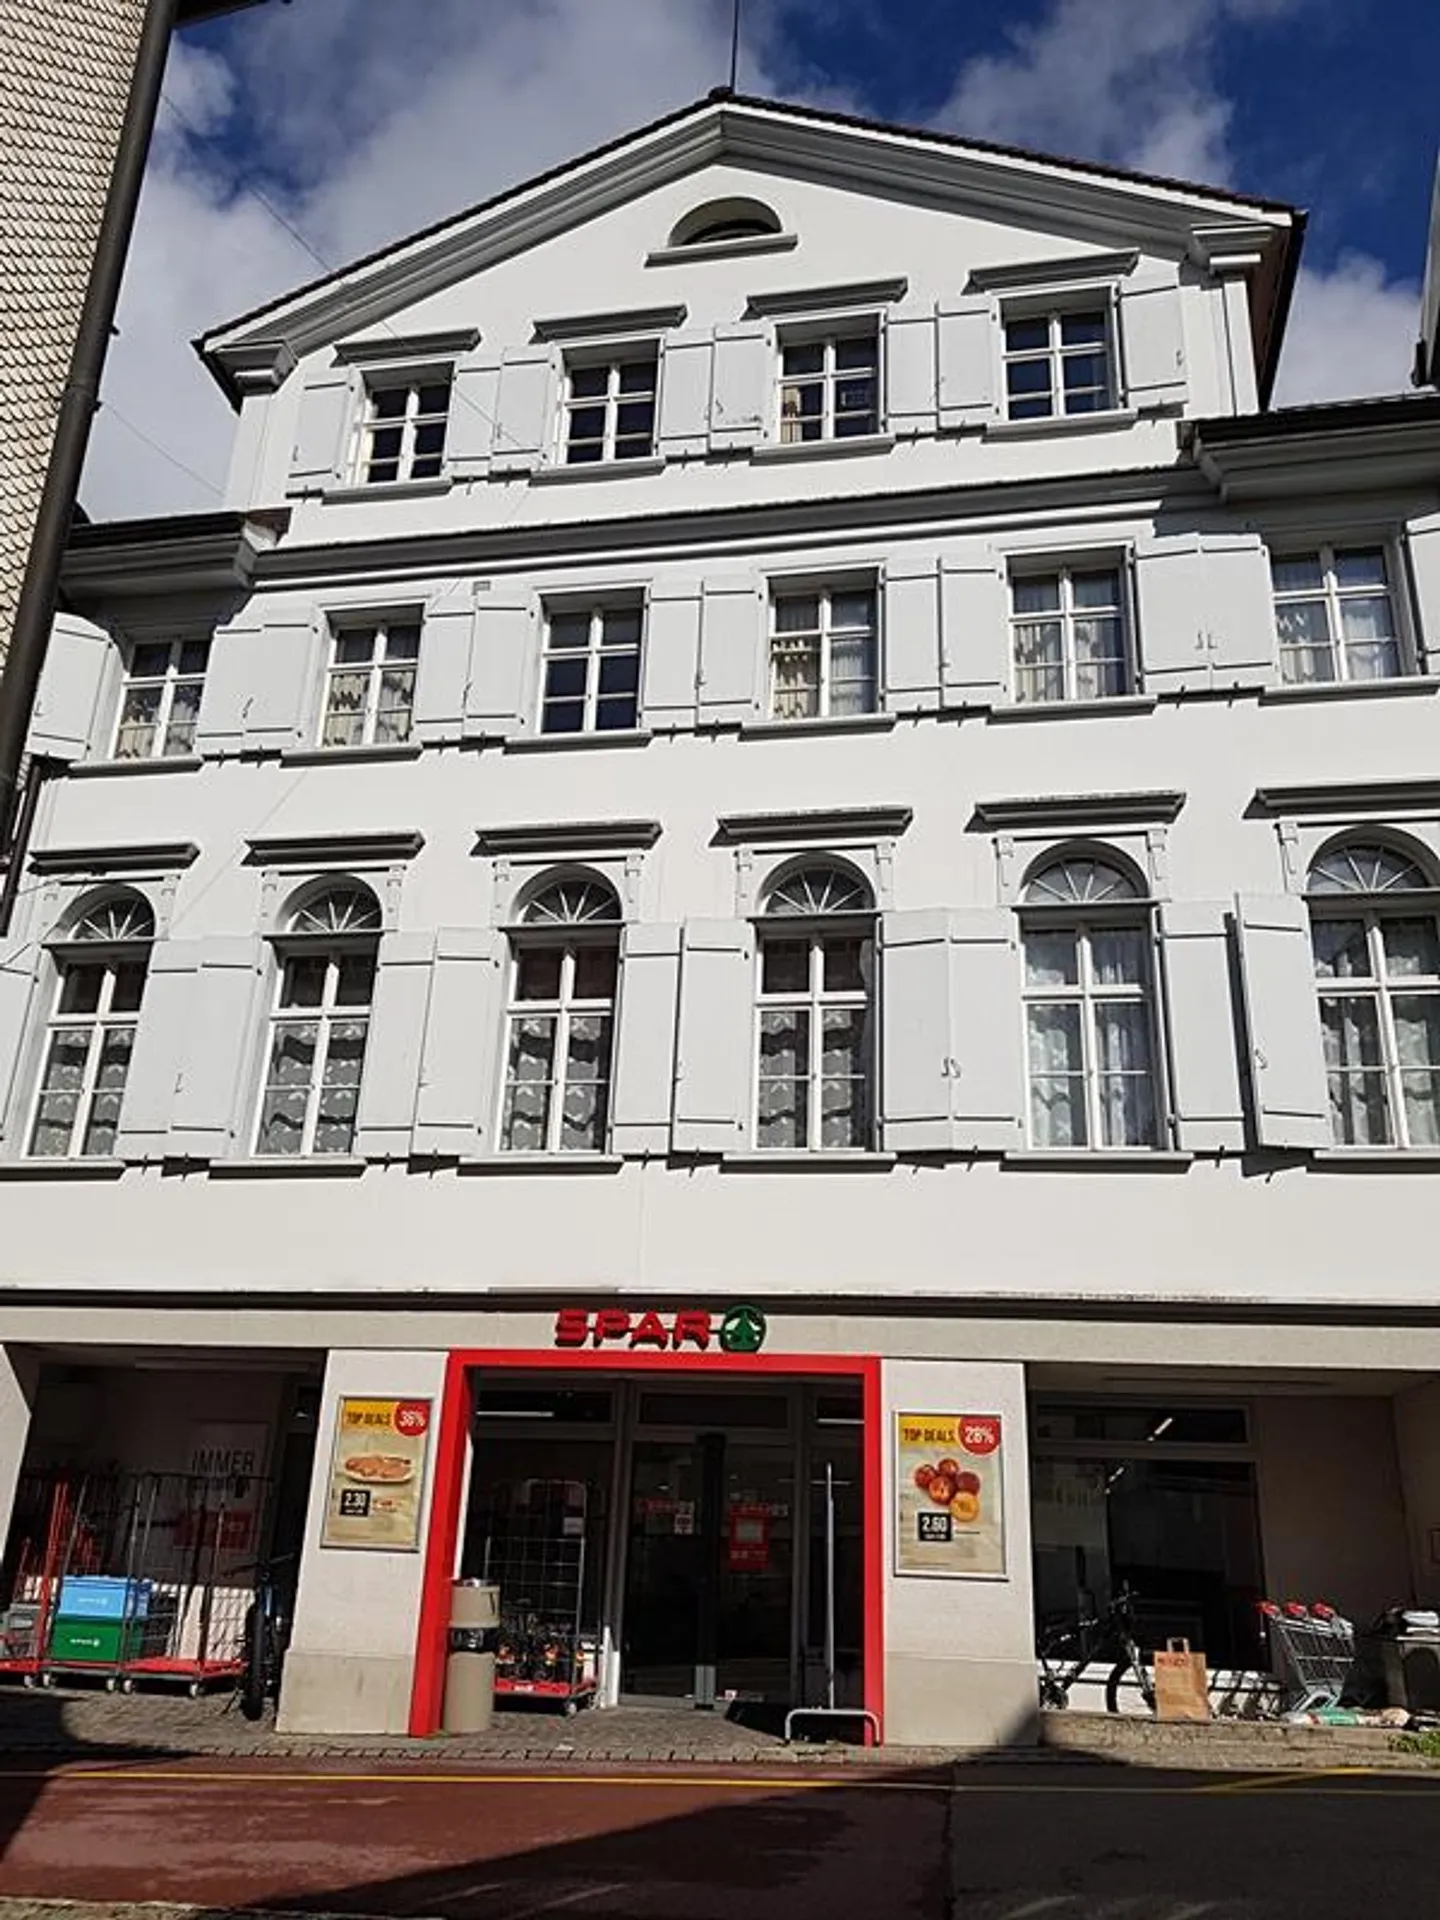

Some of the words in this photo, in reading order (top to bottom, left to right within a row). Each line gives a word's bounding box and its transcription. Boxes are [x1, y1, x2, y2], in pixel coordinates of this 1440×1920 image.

[555, 1308, 711, 1350] SPAR
[347, 1412, 365, 1425] TOP
[367, 1412, 391, 1426] DEALS
[904, 1428, 922, 1441] TOP
[924, 1428, 955, 1442] DEALS
[193, 1448, 255, 1473] IMMER
